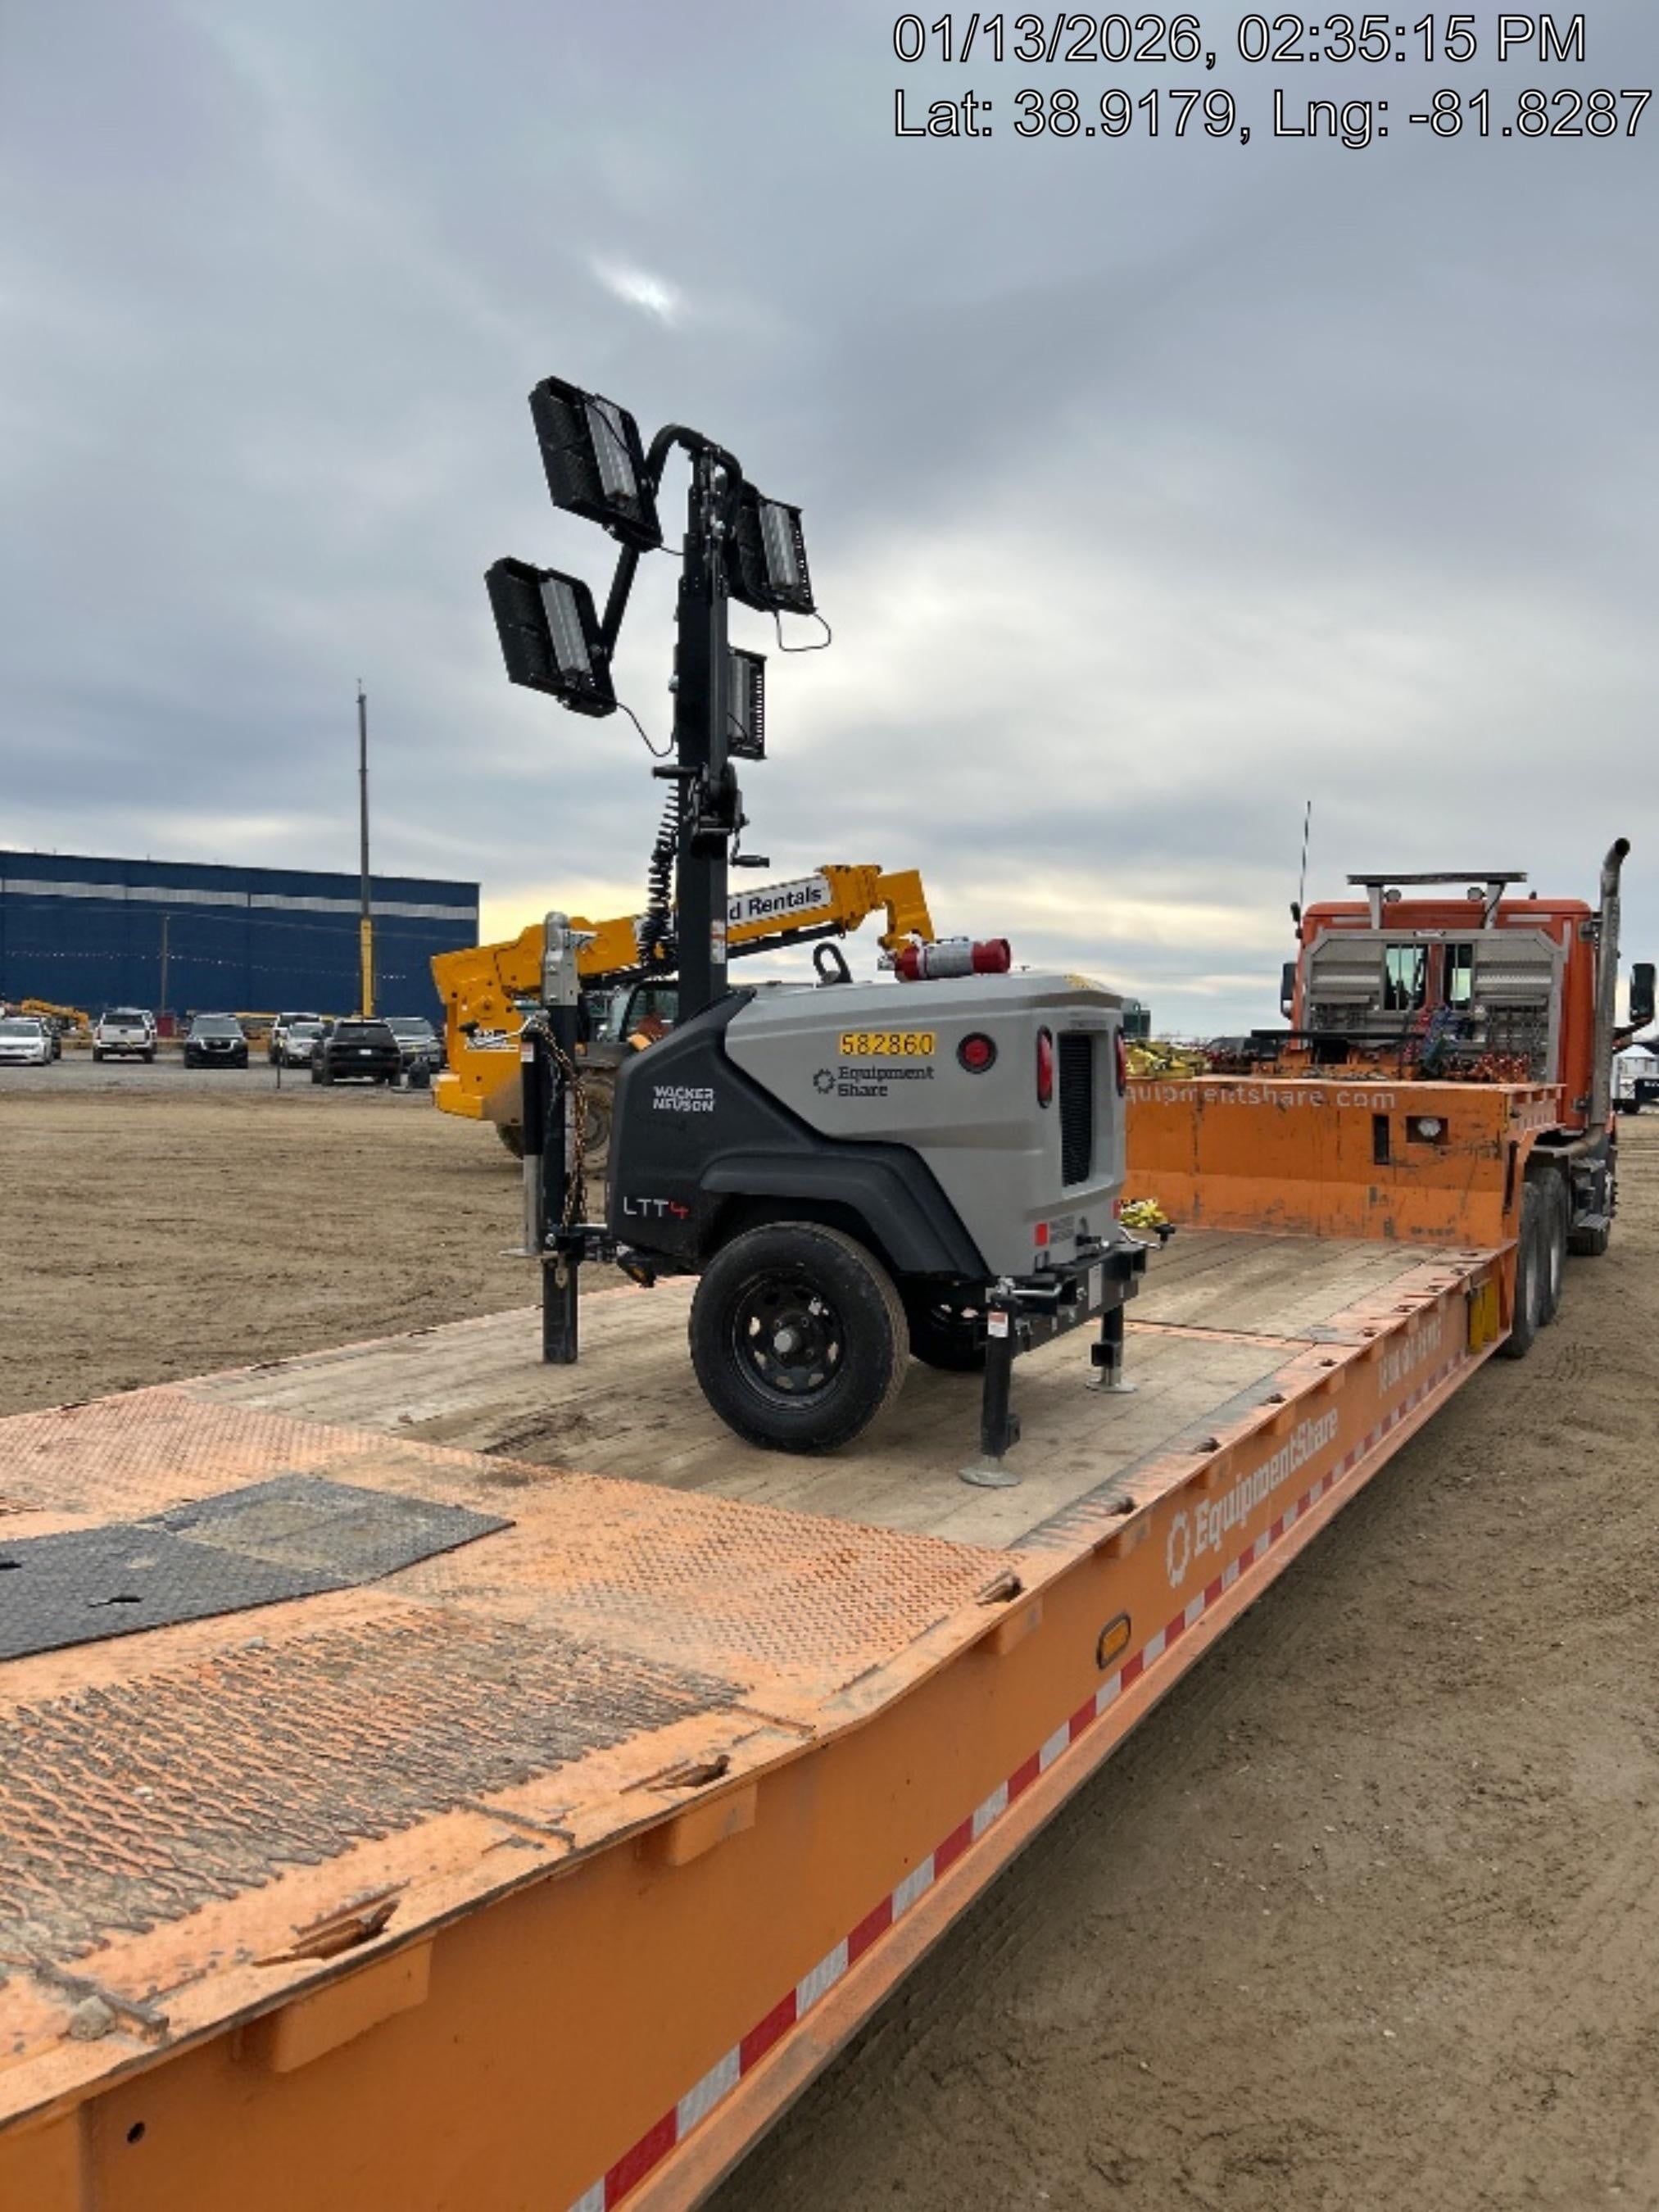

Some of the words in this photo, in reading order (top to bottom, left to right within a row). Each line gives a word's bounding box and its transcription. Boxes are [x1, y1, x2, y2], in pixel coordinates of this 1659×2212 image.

[748, 886, 822, 917] Rentals
[842, 1034, 932, 1055] 582860
[838, 1066, 935, 1083] Equipment
[654, 1086, 714, 1099] WACKER
[838, 1084, 888, 1097] Share
[653, 1098, 714, 1112] NEUSON
[623, 1196, 689, 1220] LTT4
[1194, 1407, 1338, 1557] EquipmentShare
